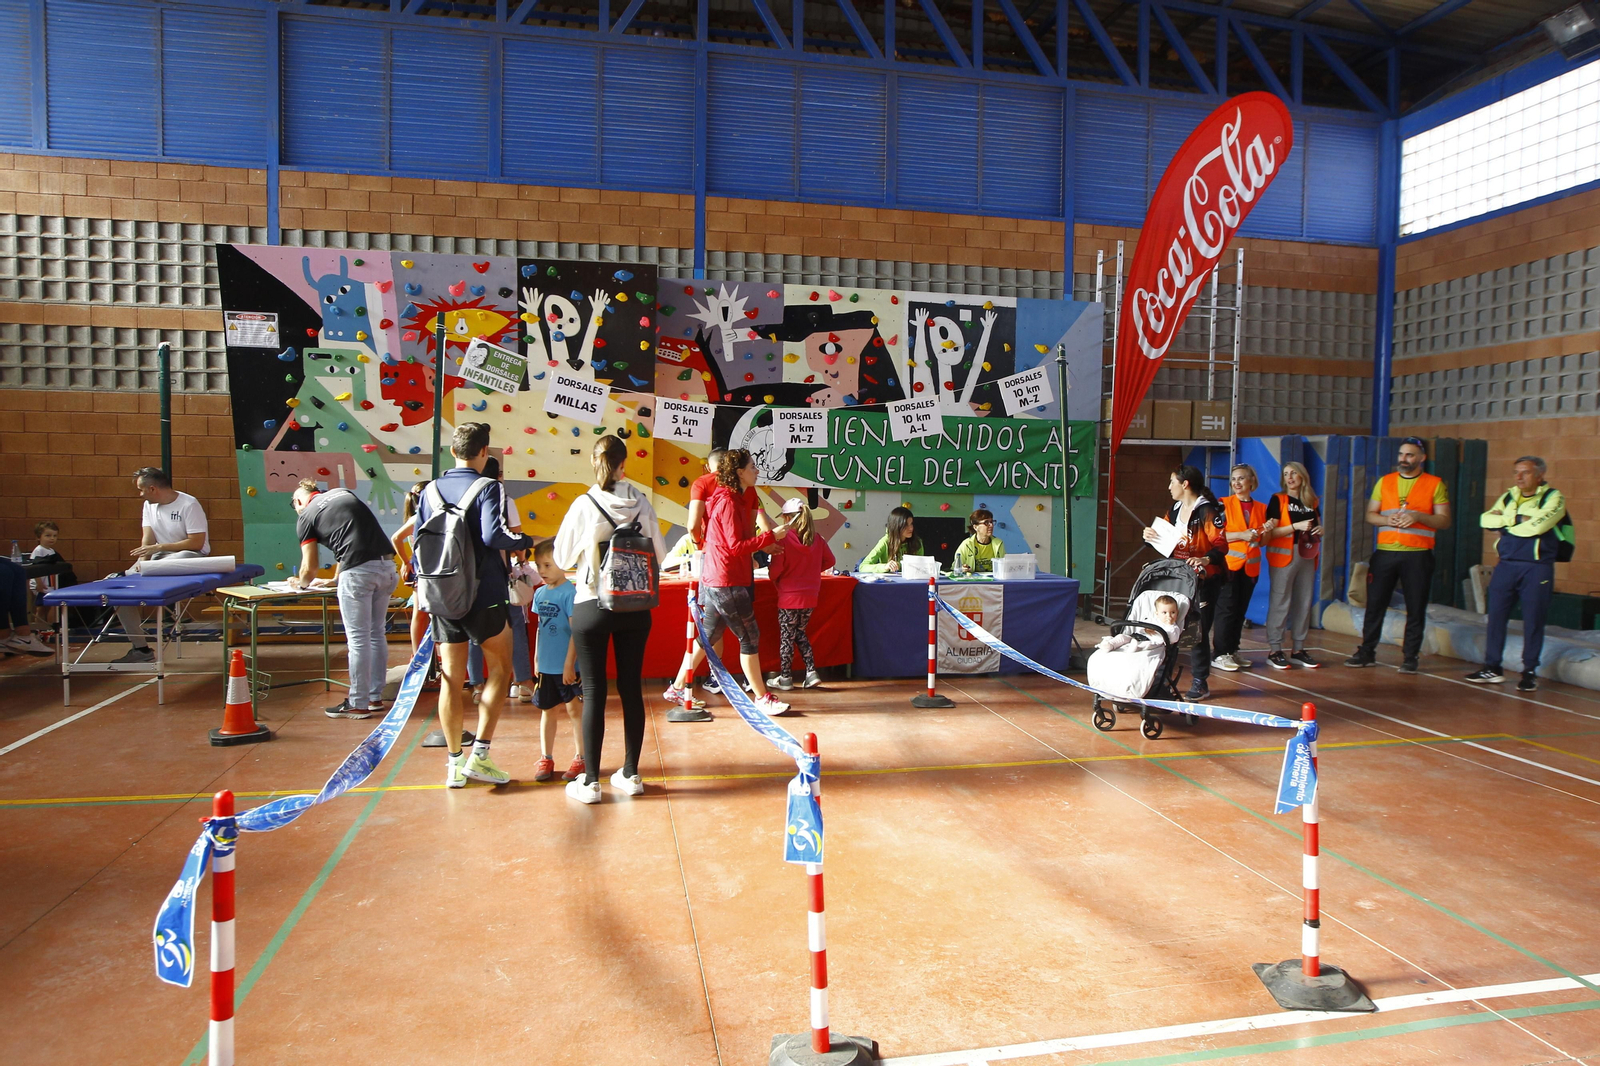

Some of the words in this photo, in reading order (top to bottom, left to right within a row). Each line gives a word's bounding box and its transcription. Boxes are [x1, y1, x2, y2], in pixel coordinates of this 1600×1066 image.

[1132, 106, 1276, 360] Coca-Cola
[493, 351, 522, 367] ENTREGA
[500, 361, 511, 370] DE
[486, 364, 519, 382] DORSALES
[1004, 370, 1043, 389] DORSALES
[463, 367, 515, 394] INFANTILES
[556, 376, 604, 396] DORSALES
[1012, 388, 1024, 399] 10
[1026, 384, 1041, 395] km
[553, 393, 598, 414] MILLAS
[663, 401, 709, 415] DORSALES
[893, 399, 935, 413] DORSALES
[1019, 394, 1041, 408] M-Z
[671, 415, 679, 424] 5
[682, 416, 699, 427] km
[779, 412, 823, 420] DORSALES
[901, 414, 914, 425] 10
[916, 411, 931, 422] km
[673, 426, 694, 438] A-L
[788, 423, 796, 433] 5
[799, 423, 815, 433] km
[833, 415, 1029, 454] IENNIDOS
[1042, 425, 1079, 453] AL
[909, 423, 928, 435] A-L
[790, 434, 814, 444] M-Z
[811, 447, 913, 486] TÚNEL
[922, 457, 970, 488] DEL
